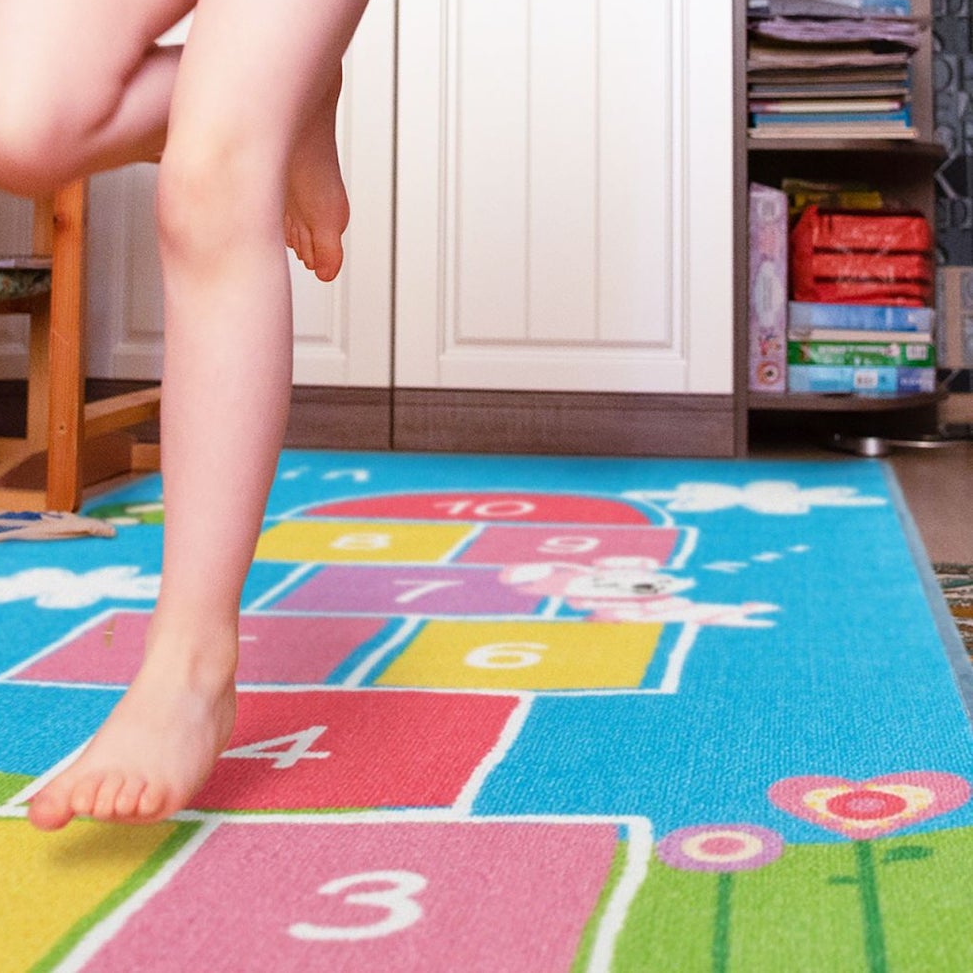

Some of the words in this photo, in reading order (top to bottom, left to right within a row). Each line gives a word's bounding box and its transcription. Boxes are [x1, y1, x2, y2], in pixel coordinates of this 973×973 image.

[433, 499, 536, 518] 10
[331, 531, 392, 551] 8
[538, 534, 601, 554] 9
[393, 579, 464, 604] 7
[463, 640, 549, 671] 6
[221, 725, 331, 769] 4
[287, 869, 428, 941] 3
